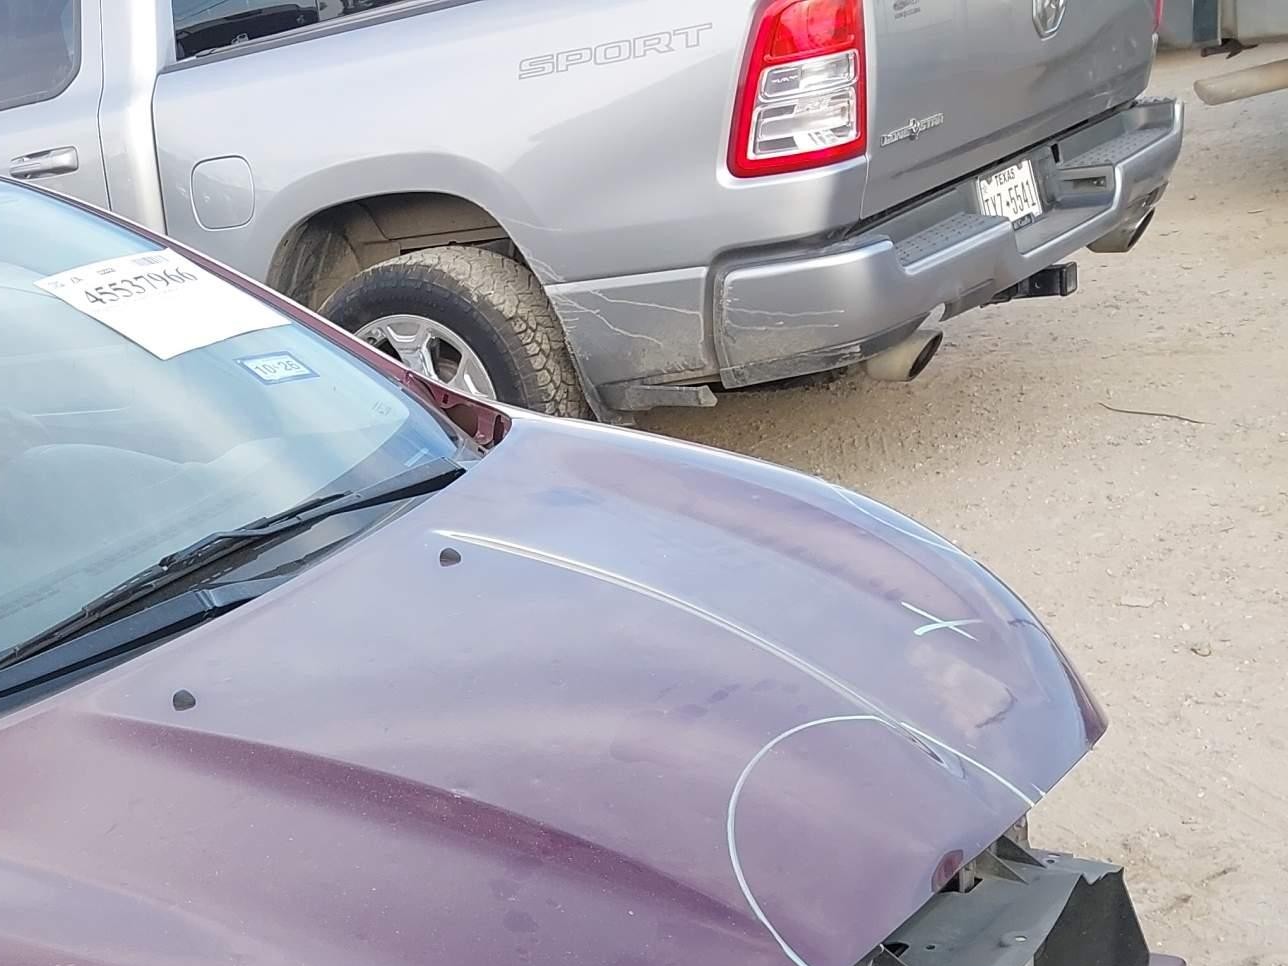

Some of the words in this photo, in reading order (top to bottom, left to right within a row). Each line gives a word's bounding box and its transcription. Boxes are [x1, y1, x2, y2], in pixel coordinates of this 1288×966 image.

[518, 22, 713, 80] SPORT
[994, 168, 1016, 187] TEXAS
[84, 267, 199, 305] 45537966
